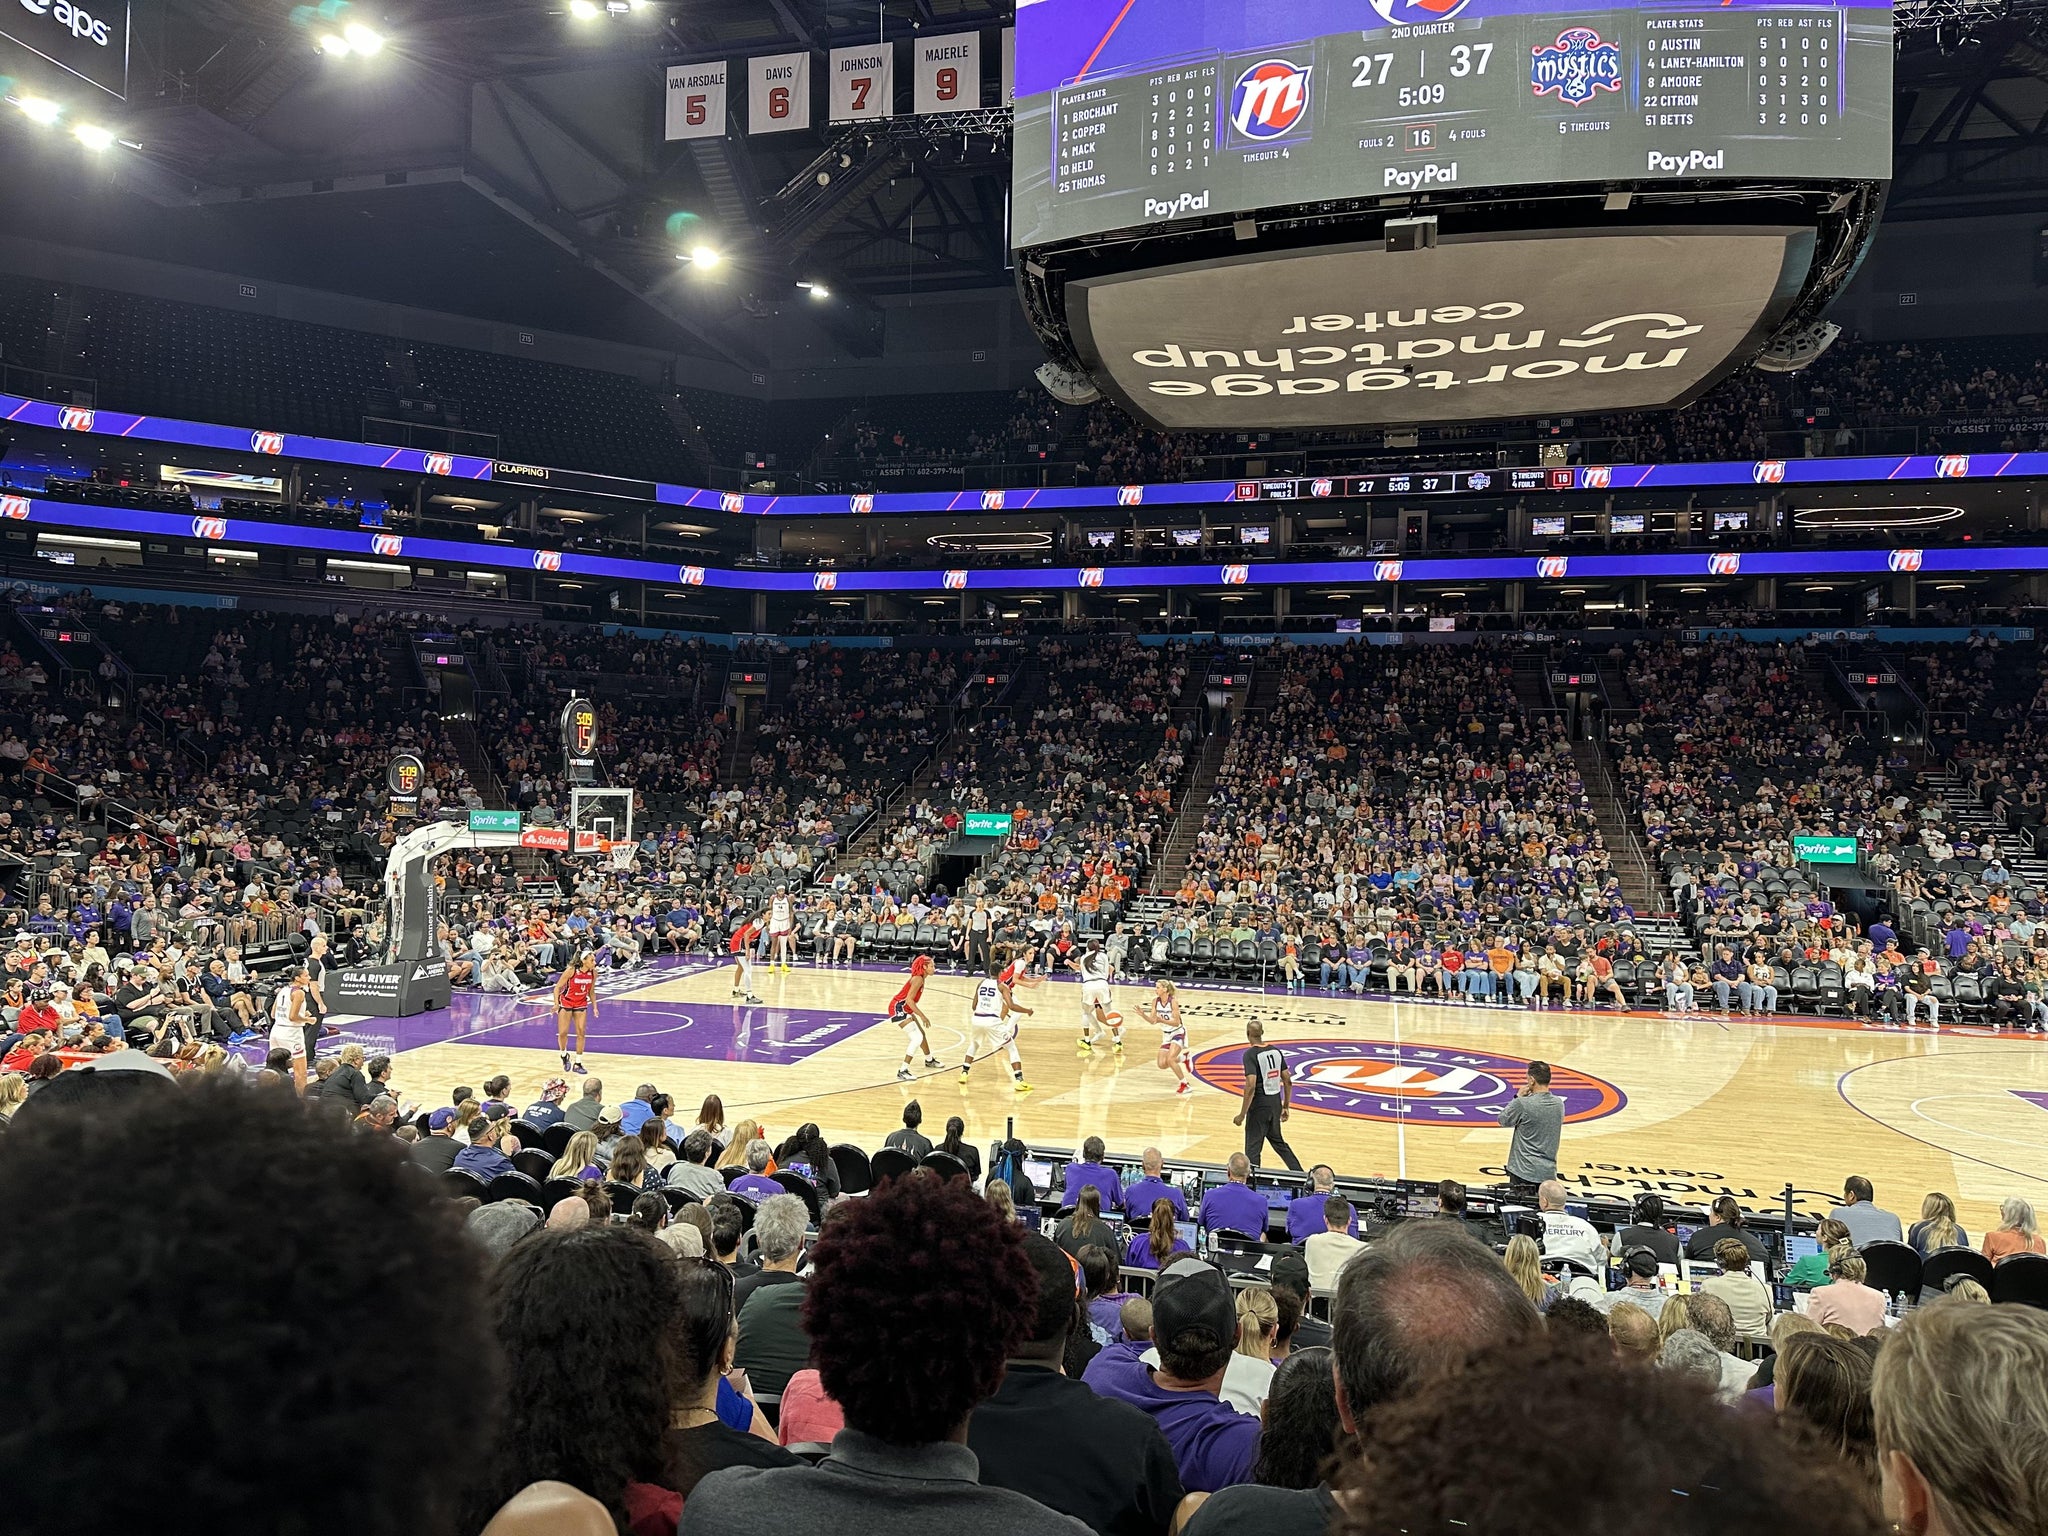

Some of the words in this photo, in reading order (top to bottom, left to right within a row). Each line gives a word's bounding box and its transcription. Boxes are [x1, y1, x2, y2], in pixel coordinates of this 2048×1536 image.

[1392, 27, 1410, 38] 2ND
[1413, 22, 1454, 37] QUARTER
[1647, 20, 1677, 29] PLAYER
[1679, 19, 1703, 28] STATS
[1778, 19, 1793, 27] REB
[1798, 19, 1812, 27] AST
[1818, 19, 1831, 27] FLS
[1649, 40, 1655, 51] 0
[1661, 38, 1700, 51] AUSTIN
[1760, 38, 1767, 49] 5
[1781, 38, 1785, 49] 1
[1802, 38, 1809, 49] 0
[1821, 38, 1827, 50] 0
[925, 45, 969, 62] MAJERLE
[839, 56, 883, 73] JOHNSON
[1352, 53, 1393, 87] 27
[1450, 43, 1493, 77] 37
[1648, 58, 1655, 69] 4
[1661, 56, 1743, 68] LANEY-HAMILTON
[1760, 56, 1766, 67] 9
[1780, 57, 1787, 67] 0
[1803, 57, 1807, 67] 1
[1821, 57, 1827, 68] 0
[669, 77, 685, 90] VAN
[687, 72, 725, 89] ARSDALE
[766, 66, 792, 81] DAVIS
[1150, 77, 1162, 86] PTS
[1168, 74, 1180, 82] REB
[1185, 70, 1197, 79] AST
[1202, 67, 1214, 76] FLS
[936, 67, 958, 101] 9
[1648, 77, 1654, 88] 8
[1661, 76, 1702, 87] AMOORE
[1760, 75, 1766, 86] 0
[1780, 75, 1786, 86] 3
[1802, 76, 1808, 86] 2
[1821, 76, 1827, 87] 0
[850, 78, 871, 110] 7
[1062, 94, 1085, 105] PLAYER
[1087, 89, 1107, 99] STATS
[1399, 84, 1444, 106] 5:09
[1644, 96, 1657, 107] 22
[1661, 95, 1698, 106] CITRON
[1760, 94, 1766, 105] 3
[1781, 94, 1785, 105] 1
[1802, 95, 1808, 105] 3
[1820, 95, 1826, 105] 0
[686, 94, 706, 125] 5
[769, 87, 789, 119] 6
[1064, 115, 1067, 124] 1
[1073, 103, 1118, 122] BROCHANT
[1152, 95, 1158, 105] 3
[1170, 92, 1175, 102] 0
[1188, 89, 1193, 99] 0
[1205, 86, 1210, 96] 0
[1063, 131, 1068, 142] 2
[1073, 123, 1105, 139] COPPER
[1152, 112, 1158, 123] 7
[1169, 110, 1175, 120] 2
[1187, 106, 1193, 117] 2
[1205, 103, 1209, 114] 1
[1646, 115, 1656, 126] 51
[1660, 114, 1693, 125] BETTS
[1760, 113, 1766, 124] 3
[1780, 113, 1786, 124] 2
[1801, 114, 1808, 124] 0
[1820, 114, 1826, 125] 0
[1560, 122, 1566, 133] 5
[1571, 122, 1610, 131] TIMEOUTS
[1062, 148, 1067, 158] 4
[1072, 142, 1095, 156] MACK
[1152, 130, 1157, 140] 8
[1169, 127, 1174, 137] 3
[1187, 124, 1192, 134] 0
[1204, 121, 1210, 131] 2
[1359, 139, 1383, 148] FOULS
[1387, 136, 1394, 147] 2
[1413, 130, 1430, 146] 16
[1449, 130, 1456, 141] 4
[1461, 129, 1485, 139] FOULS
[1060, 165, 1069, 176] 10
[1072, 160, 1093, 173] HELD
[1152, 147, 1157, 158] 0
[1169, 144, 1174, 155] 0
[1187, 141, 1191, 152] 1
[1204, 138, 1209, 149] 0
[1243, 151, 1278, 162] TIMEOUTS
[1282, 148, 1289, 158] 4
[1648, 150, 1723, 175] PayPal
[1059, 181, 1069, 193] 25
[1072, 174, 1105, 190] THOMAS
[1151, 165, 1157, 175] 6
[1168, 162, 1174, 172] 2
[1186, 159, 1192, 169] 2
[1204, 156, 1208, 166] 1
[1384, 161, 1459, 191] PayPal
[1145, 190, 1209, 219] PayPal
[1283, 301, 1525, 336] center
[1132, 330, 1546, 373] matchup
[1148, 347, 1689, 398] mortgage
[1953, 425, 1991, 434] ASSIST
[499, 464, 544, 477] CLAPPING
[1512, 472, 1517, 480] 5
[1423, 479, 1438, 490] 37
[1512, 480, 1517, 488] 4
[1558, 474, 1568, 483] 16
[1242, 487, 1250, 495] 16
[1359, 481, 1374, 492] 27
[1388, 482, 1410, 491] 5:09
[576, 712, 593, 726] 5:09
[578, 726, 591, 748] 15
[399, 766, 417, 776] 5:09
[401, 777, 413, 789] 15
[472, 815, 498, 826] Sprite
[967, 819, 993, 829] Sprite
[537, 835, 556, 845] State
[342, 973, 366, 982] GILA
[367, 974, 399, 984] RIVER
[979, 986, 996, 997] 25
[1266, 1054, 1276, 1069] 11
[1283, 1045, 1489, 1064] MERCU
[1579, 1161, 1725, 1181] center
